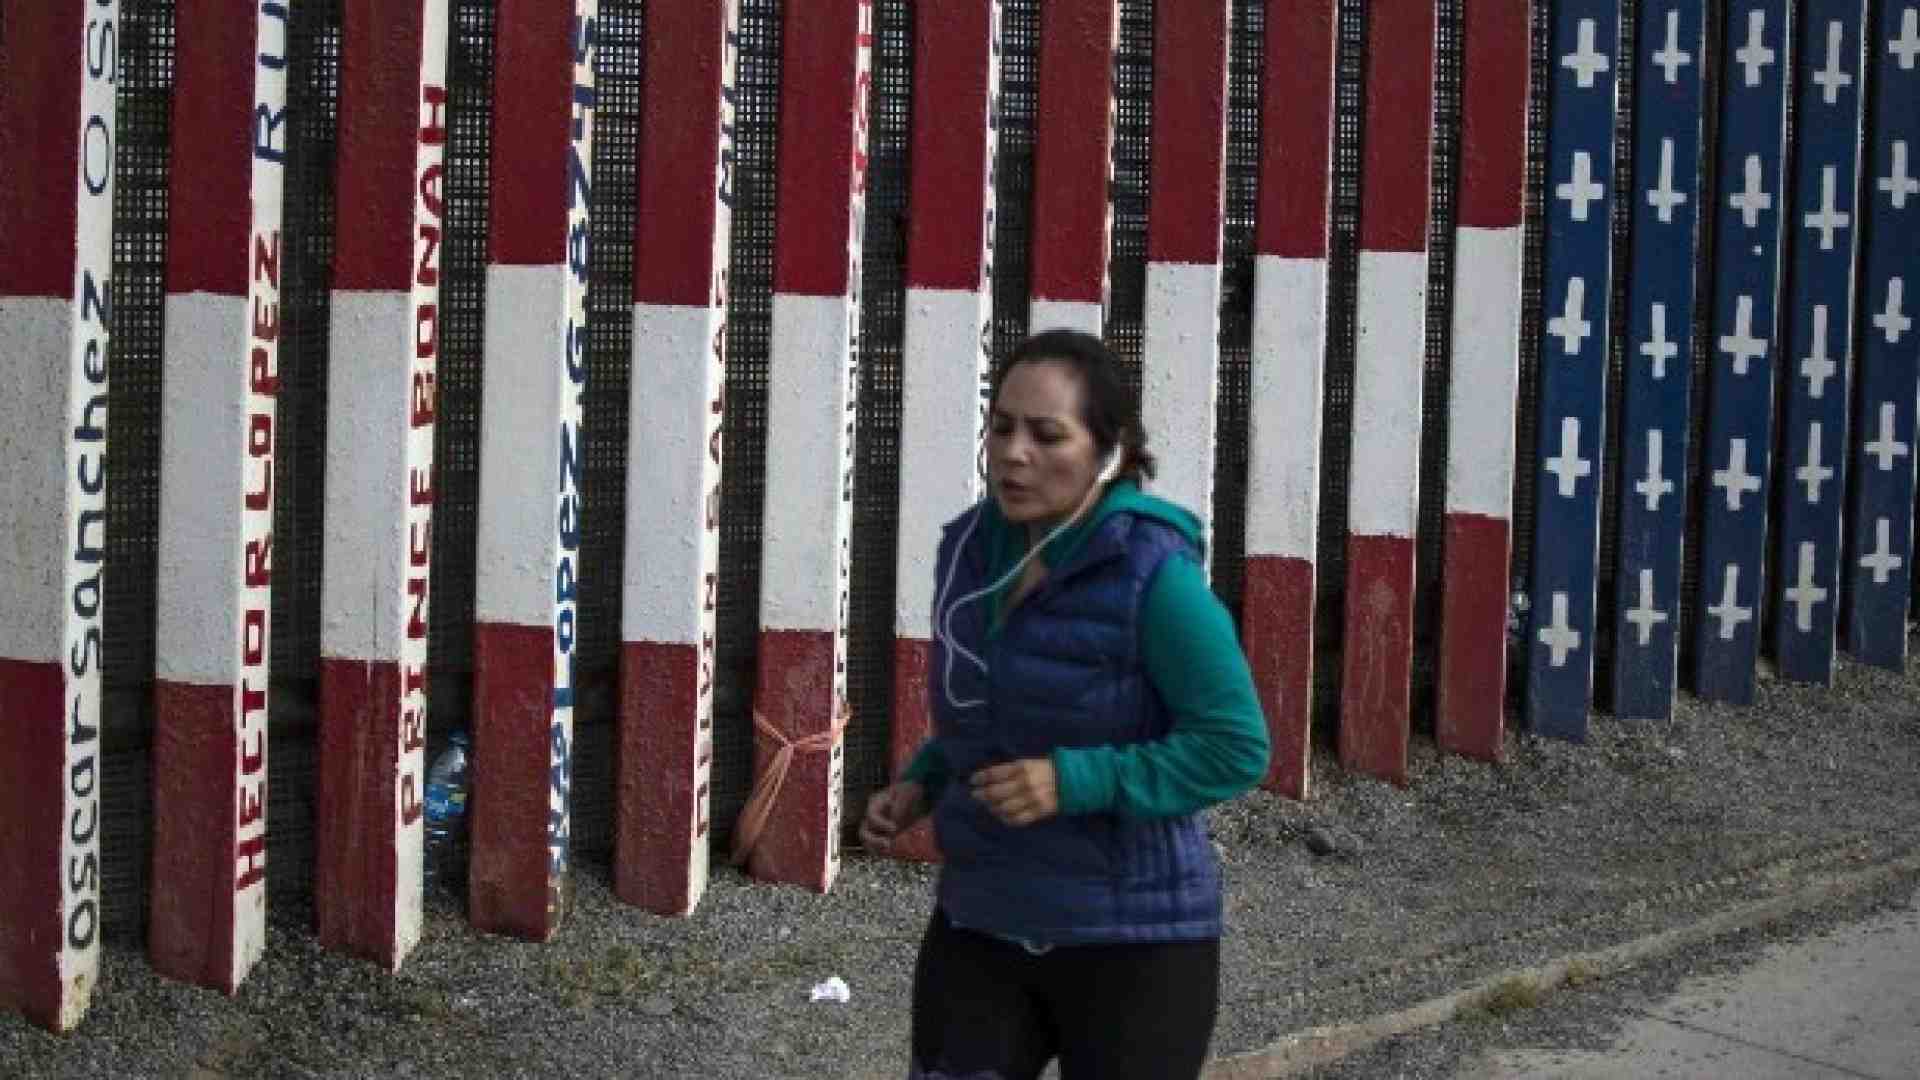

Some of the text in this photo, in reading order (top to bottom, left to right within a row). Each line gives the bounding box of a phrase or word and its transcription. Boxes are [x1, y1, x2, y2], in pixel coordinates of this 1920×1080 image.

[236, 231, 281, 890] HECTOR LOPEZ
[402, 468, 433, 825] PRINCE
